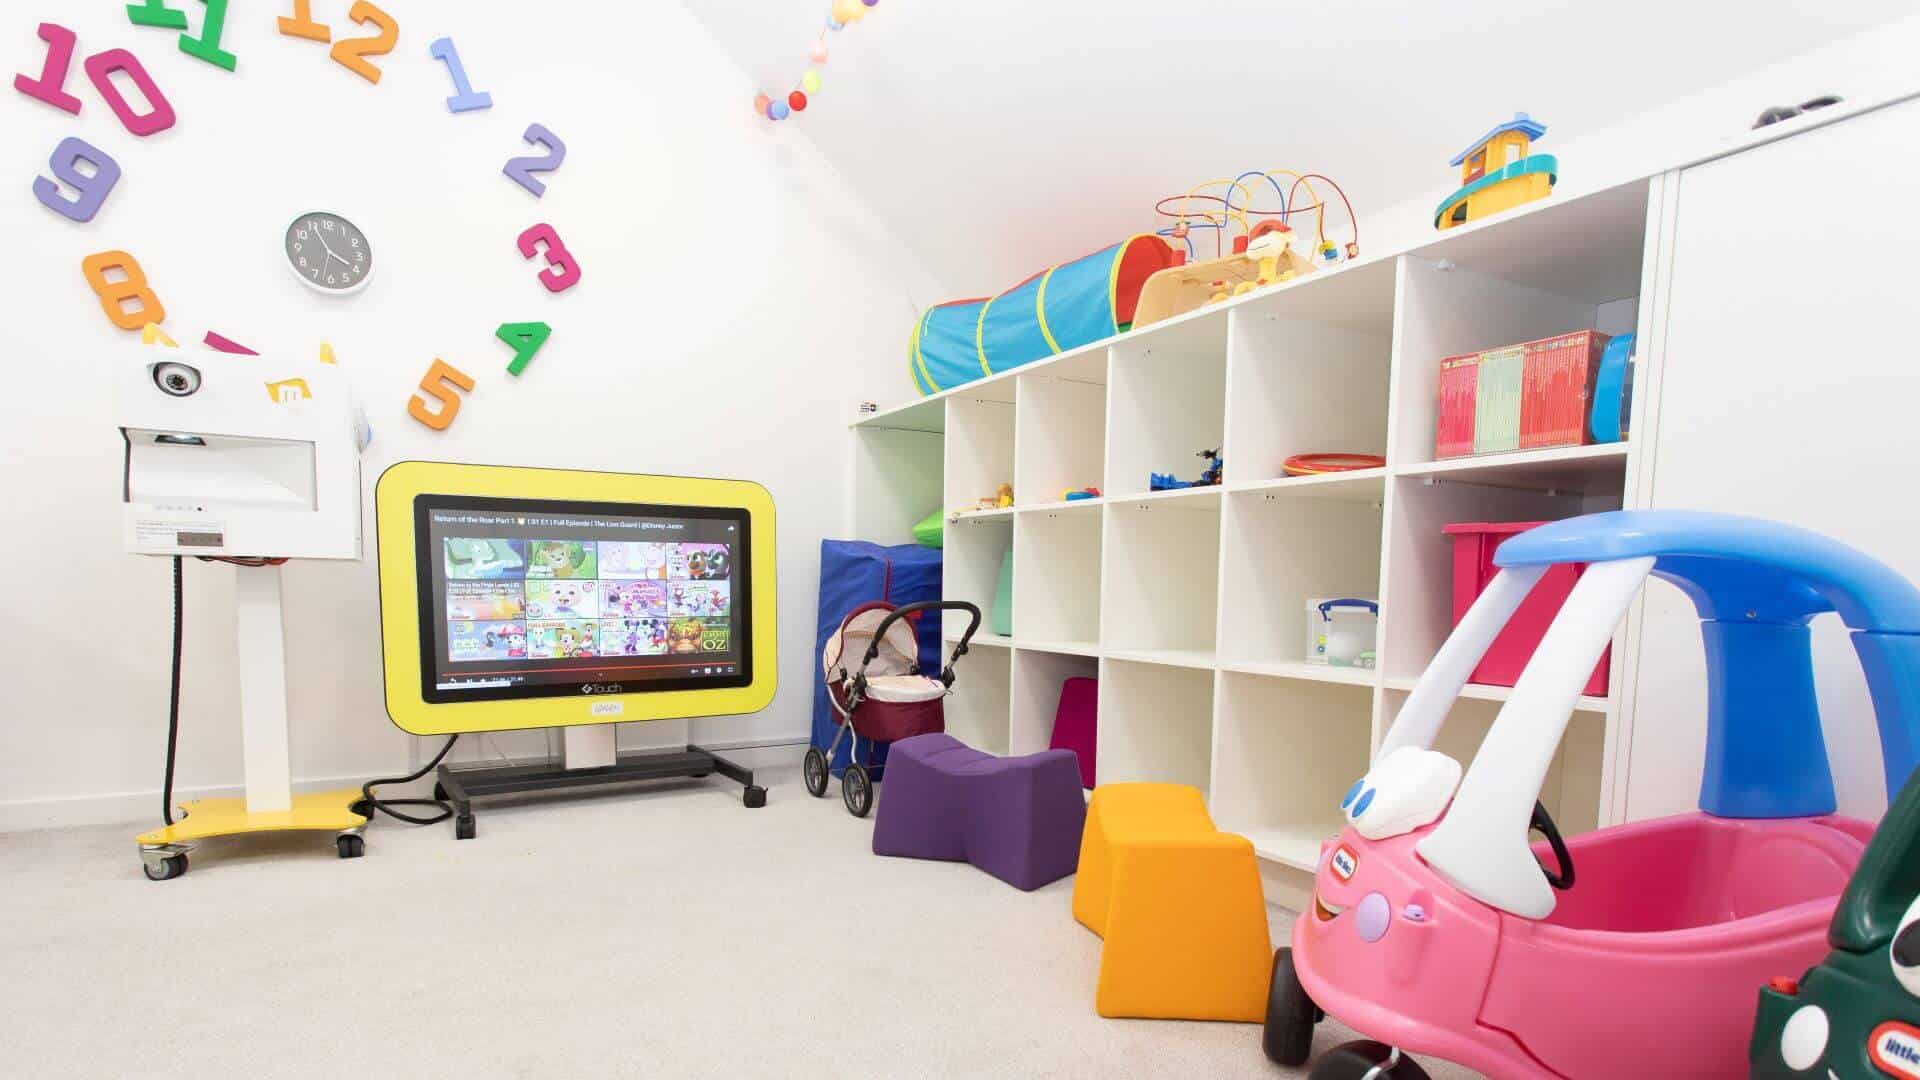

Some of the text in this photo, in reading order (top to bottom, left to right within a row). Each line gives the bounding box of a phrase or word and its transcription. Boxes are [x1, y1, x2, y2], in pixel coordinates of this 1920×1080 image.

[14, 22, 176, 137] 10
[430, 37, 493, 113] 1
[502, 123, 566, 198] 2
[32, 136, 121, 223] 9
[323, 220, 335, 231] 12
[295, 228, 308, 240] 10
[294, 242, 302, 252] 9
[351, 238, 360, 248] 2
[299, 256, 307, 267] 8
[353, 251, 363, 262] 3
[517, 223, 581, 293] 3
[312, 268, 319, 279] 7
[352, 265, 360, 273] 4
[327, 274, 335, 284] 6
[343, 272, 350, 283] 5
[81, 250, 165, 330] 8
[495, 321, 552, 377] 4
[407, 358, 475, 431] 5
[703, 639, 726, 650] OZ
[1885, 1037, 1920, 1065] little
